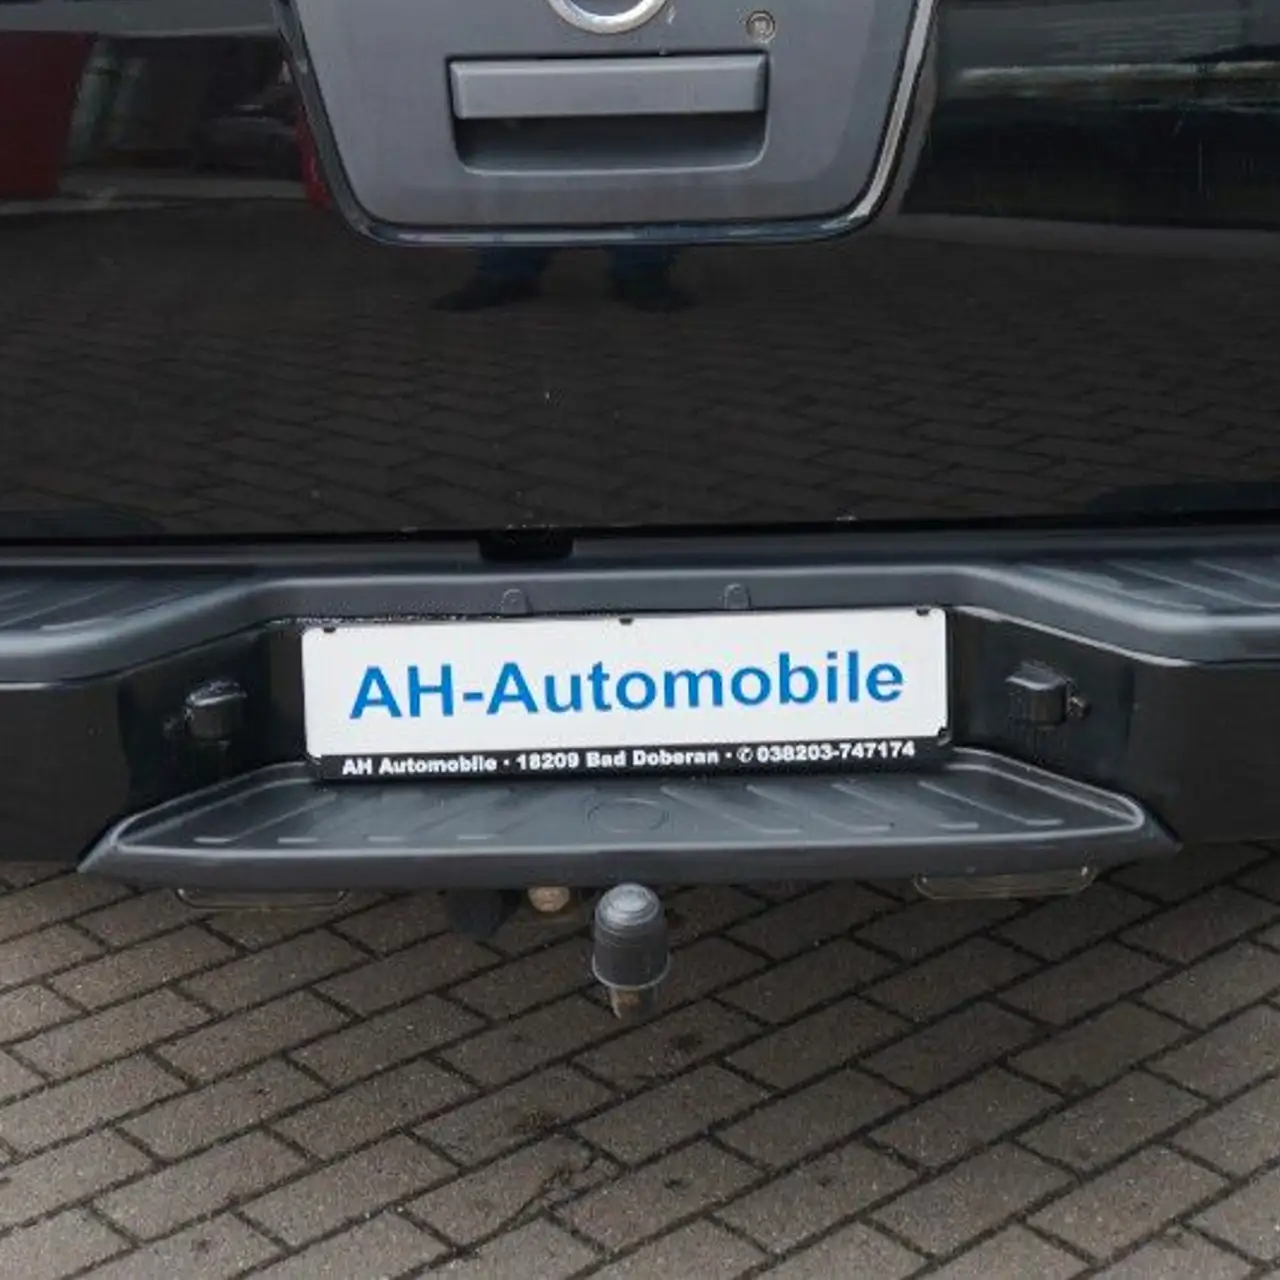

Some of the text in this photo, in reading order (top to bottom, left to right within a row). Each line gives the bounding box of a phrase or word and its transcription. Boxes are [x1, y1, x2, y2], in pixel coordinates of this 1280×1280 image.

[348, 650, 905, 721] AH-Automobile
[341, 740, 915, 777] AH Automobile 18209 Bad Doberan 038203-747174
